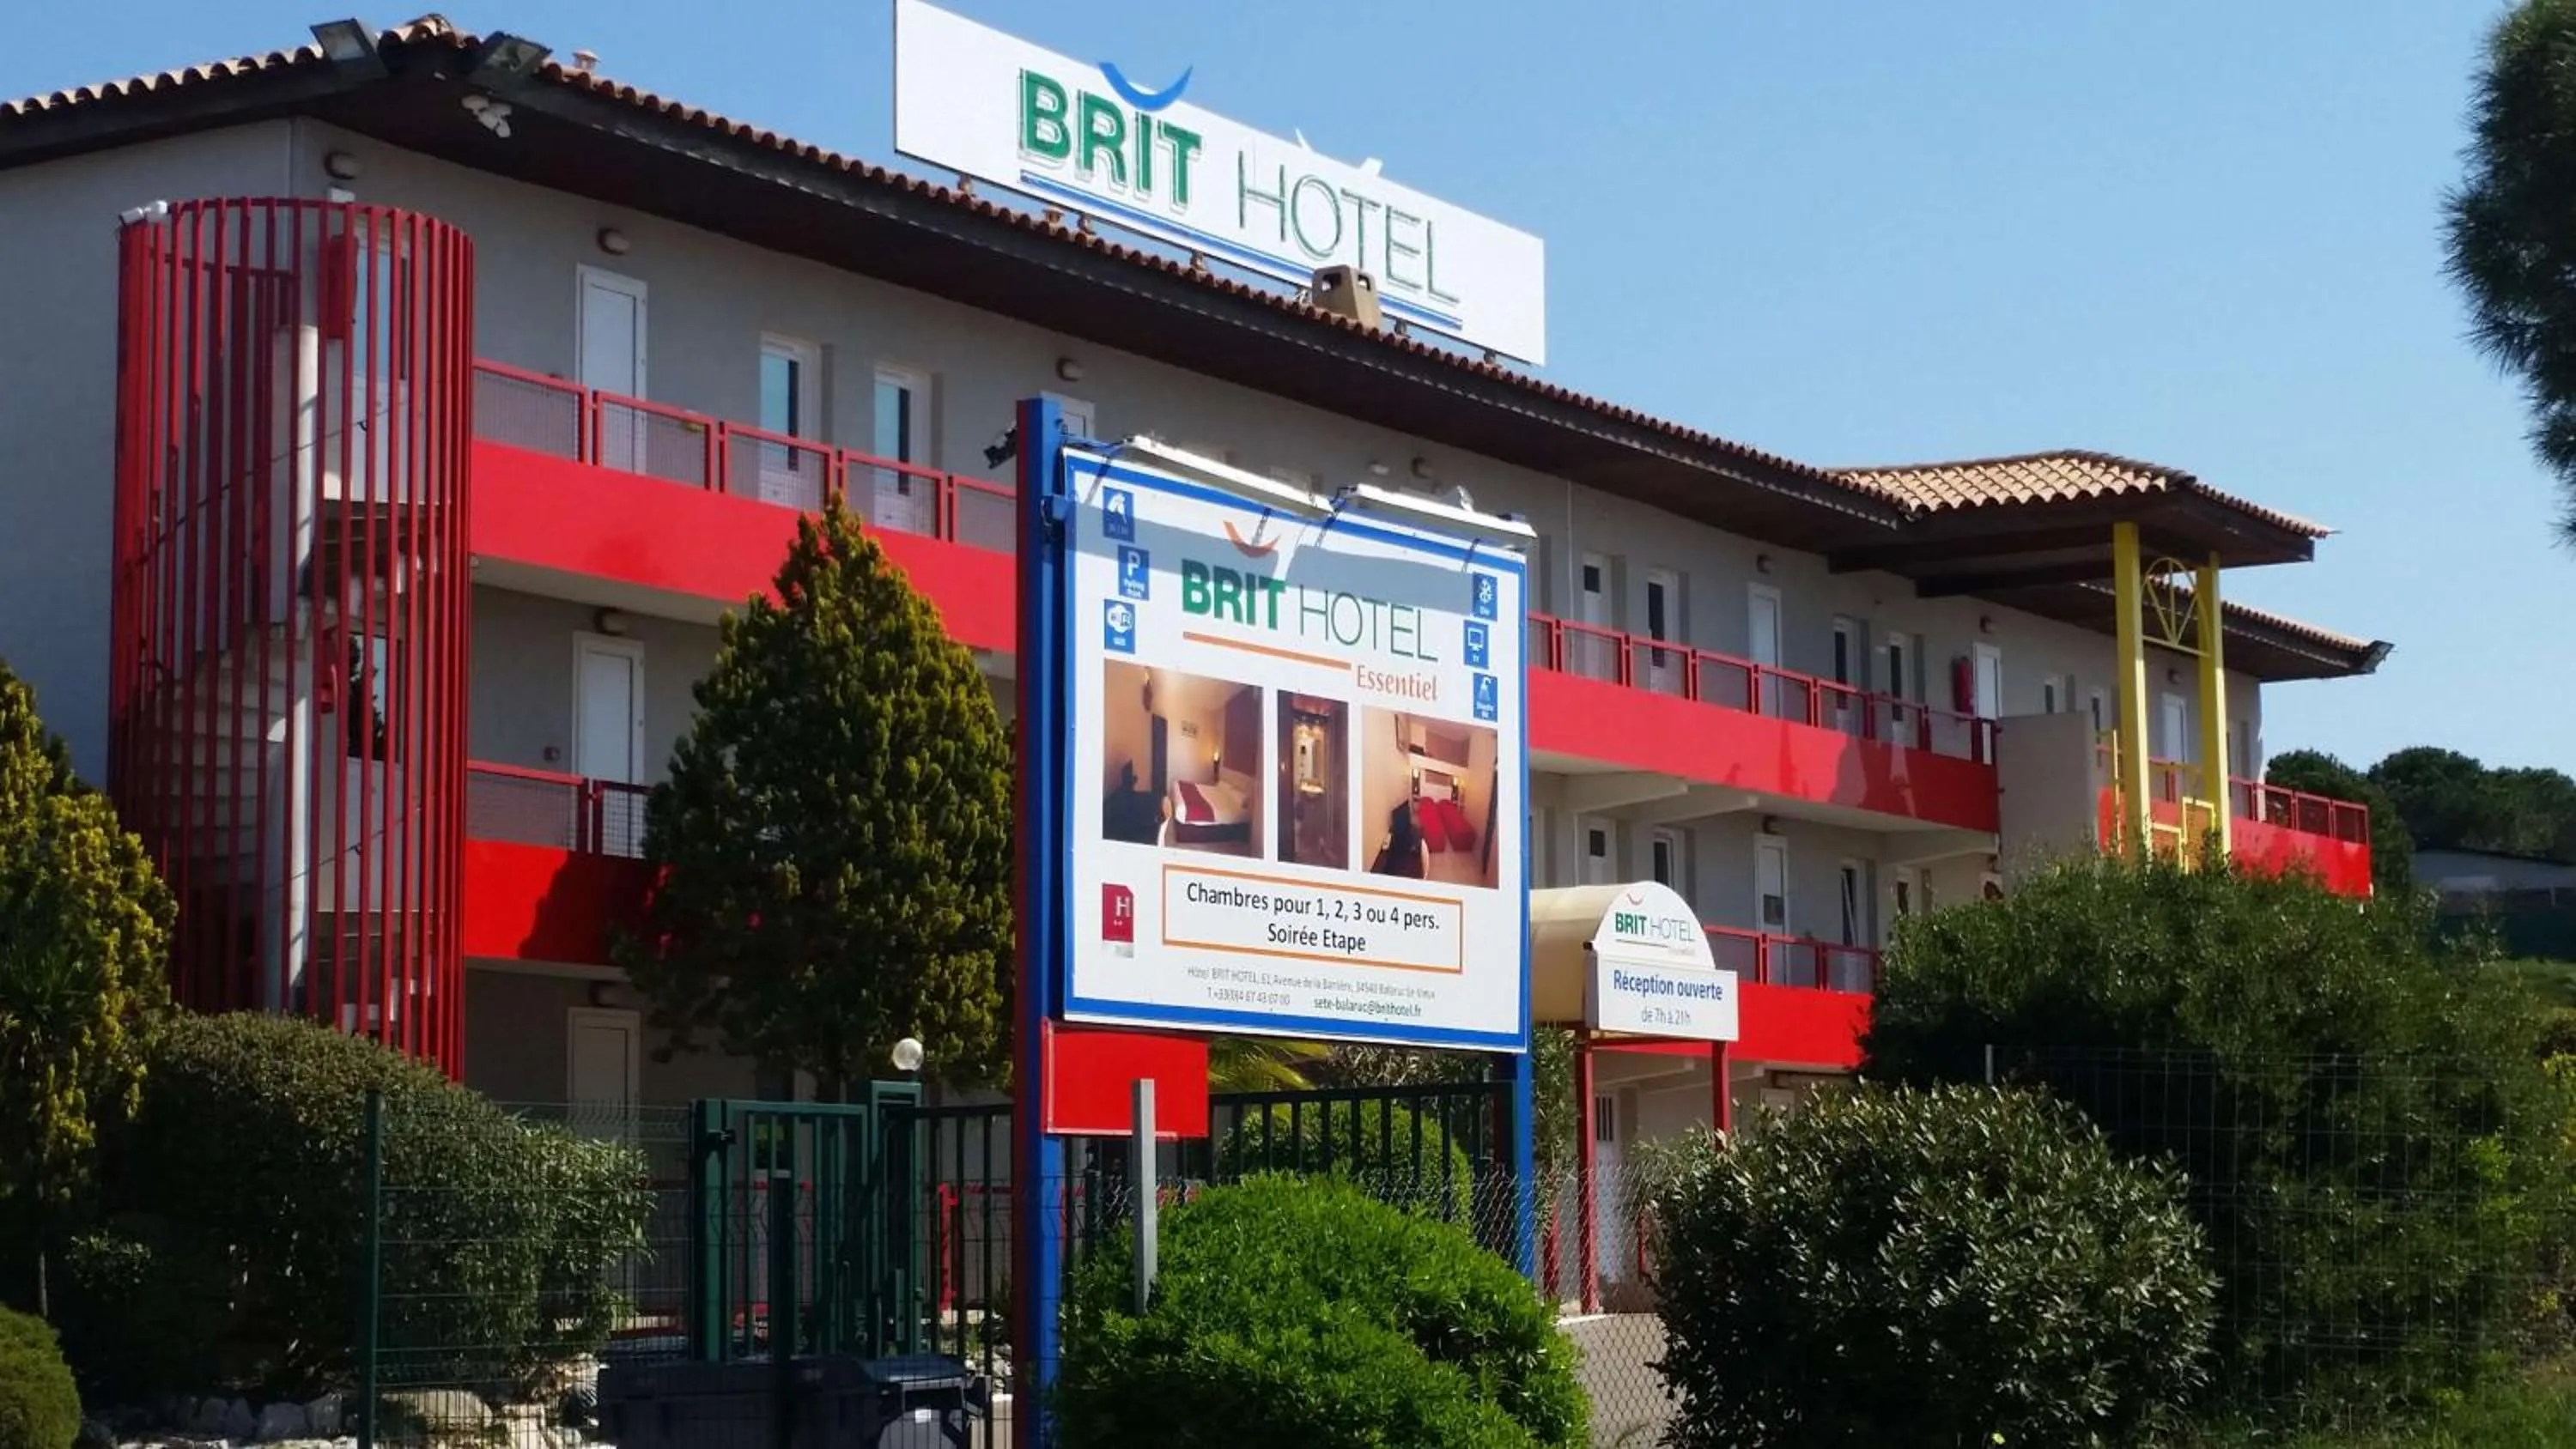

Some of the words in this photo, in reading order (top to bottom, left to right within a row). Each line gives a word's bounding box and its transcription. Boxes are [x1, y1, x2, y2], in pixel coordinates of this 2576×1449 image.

[1018, 68, 1201, 214] BRIT
[1236, 149, 1460, 304] HOTEL
[1127, 550, 1140, 577] P
[1182, 559, 1286, 630] BRIT
[1299, 584, 1438, 663] HOTEL
[1357, 664, 1438, 702] Essentiel
[1115, 895, 1130, 918] H
[1187, 882, 1268, 912] Chambres
[1273, 896, 1312, 921] pour
[1316, 897, 1330, 921] 1,
[1334, 900, 1349, 924] 2,
[1352, 901, 1362, 921] 3
[1366, 906, 1386, 925] ou
[1389, 906, 1400, 925] 4
[1404, 912, 1440, 933] pers.
[1267, 922, 1318, 947] Soirée
[1323, 928, 1366, 953] Etape
[1615, 912, 1647, 936] BRIT
[1650, 915, 1695, 942] HOTEL
[1613, 969, 1674, 998] Réception
[1677, 979, 1722, 1001] ouverte
[1641, 1007, 1653, 1022] de
